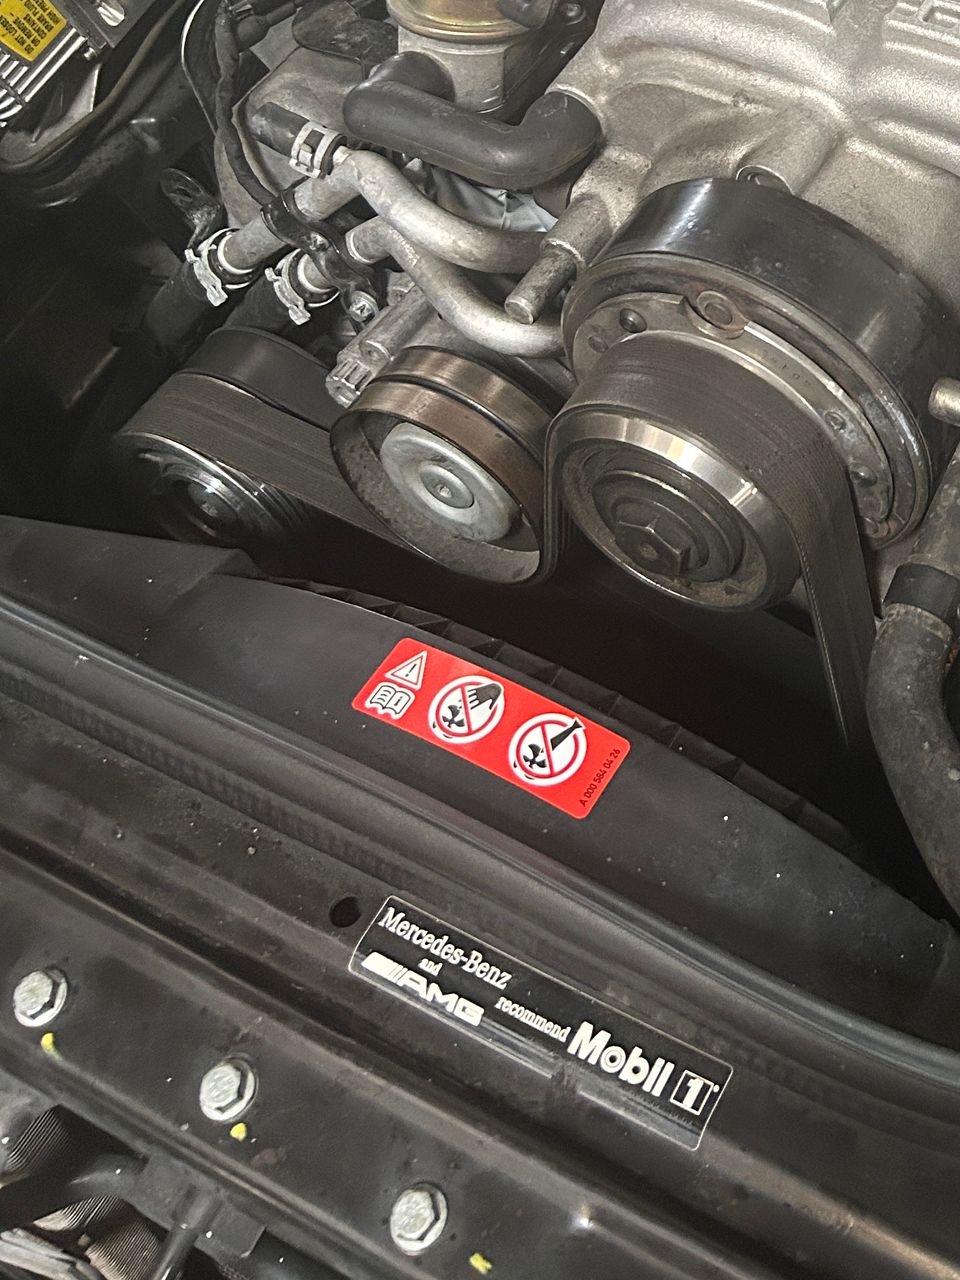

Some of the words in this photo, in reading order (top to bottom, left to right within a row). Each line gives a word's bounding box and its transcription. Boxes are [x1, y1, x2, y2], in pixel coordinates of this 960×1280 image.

[24, 0, 38, 15] FLUID
[36, 12, 55, 32] BRAKE
[46, 10, 60, 25] HIGH
[14, 17, 34, 41] REMOVE
[23, 14, 48, 39] CONTAINS
[16, 35, 28, 47] NOT
[24, 45, 34, 54] DO
[30, 37, 41, 47] OR
[610, 747, 621, 760] 26
[603, 756, 615, 771] 04
[593, 766, 609, 785] 584
[582, 779, 598, 799] 000
[578, 796, 588, 808] A
[377, 906, 513, 990] Mercedes-Benz
[418, 958, 443, 977] and
[494, 996, 571, 1043] recommend
[566, 1020, 676, 1097] Mobil
